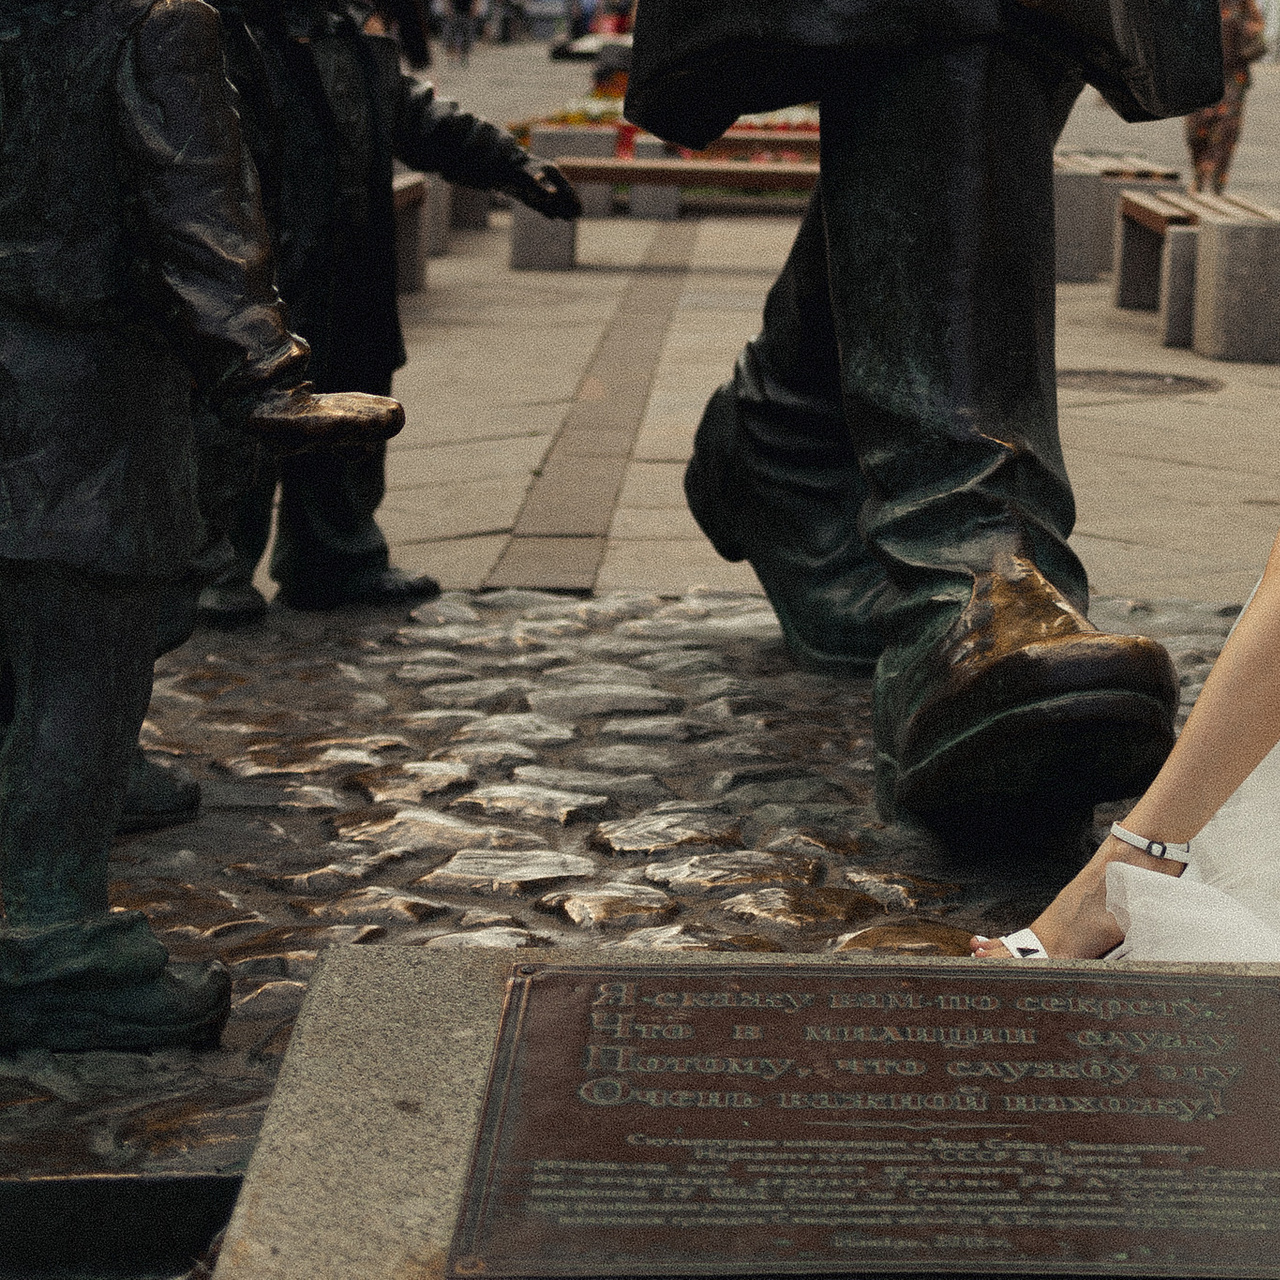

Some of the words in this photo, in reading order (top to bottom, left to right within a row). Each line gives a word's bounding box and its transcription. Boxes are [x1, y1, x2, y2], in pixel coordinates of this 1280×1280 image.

[591, 982, 637, 1007] Я
[828, 992, 923, 1009] вам
[937, 995, 1001, 1011] по
[589, 1011, 696, 1040] Что
[835, 1058, 928, 1076] что
[946, 1058, 1140, 1085] службу
[577, 1077, 763, 1109] Очень
[779, 1085, 990, 1111] важной
